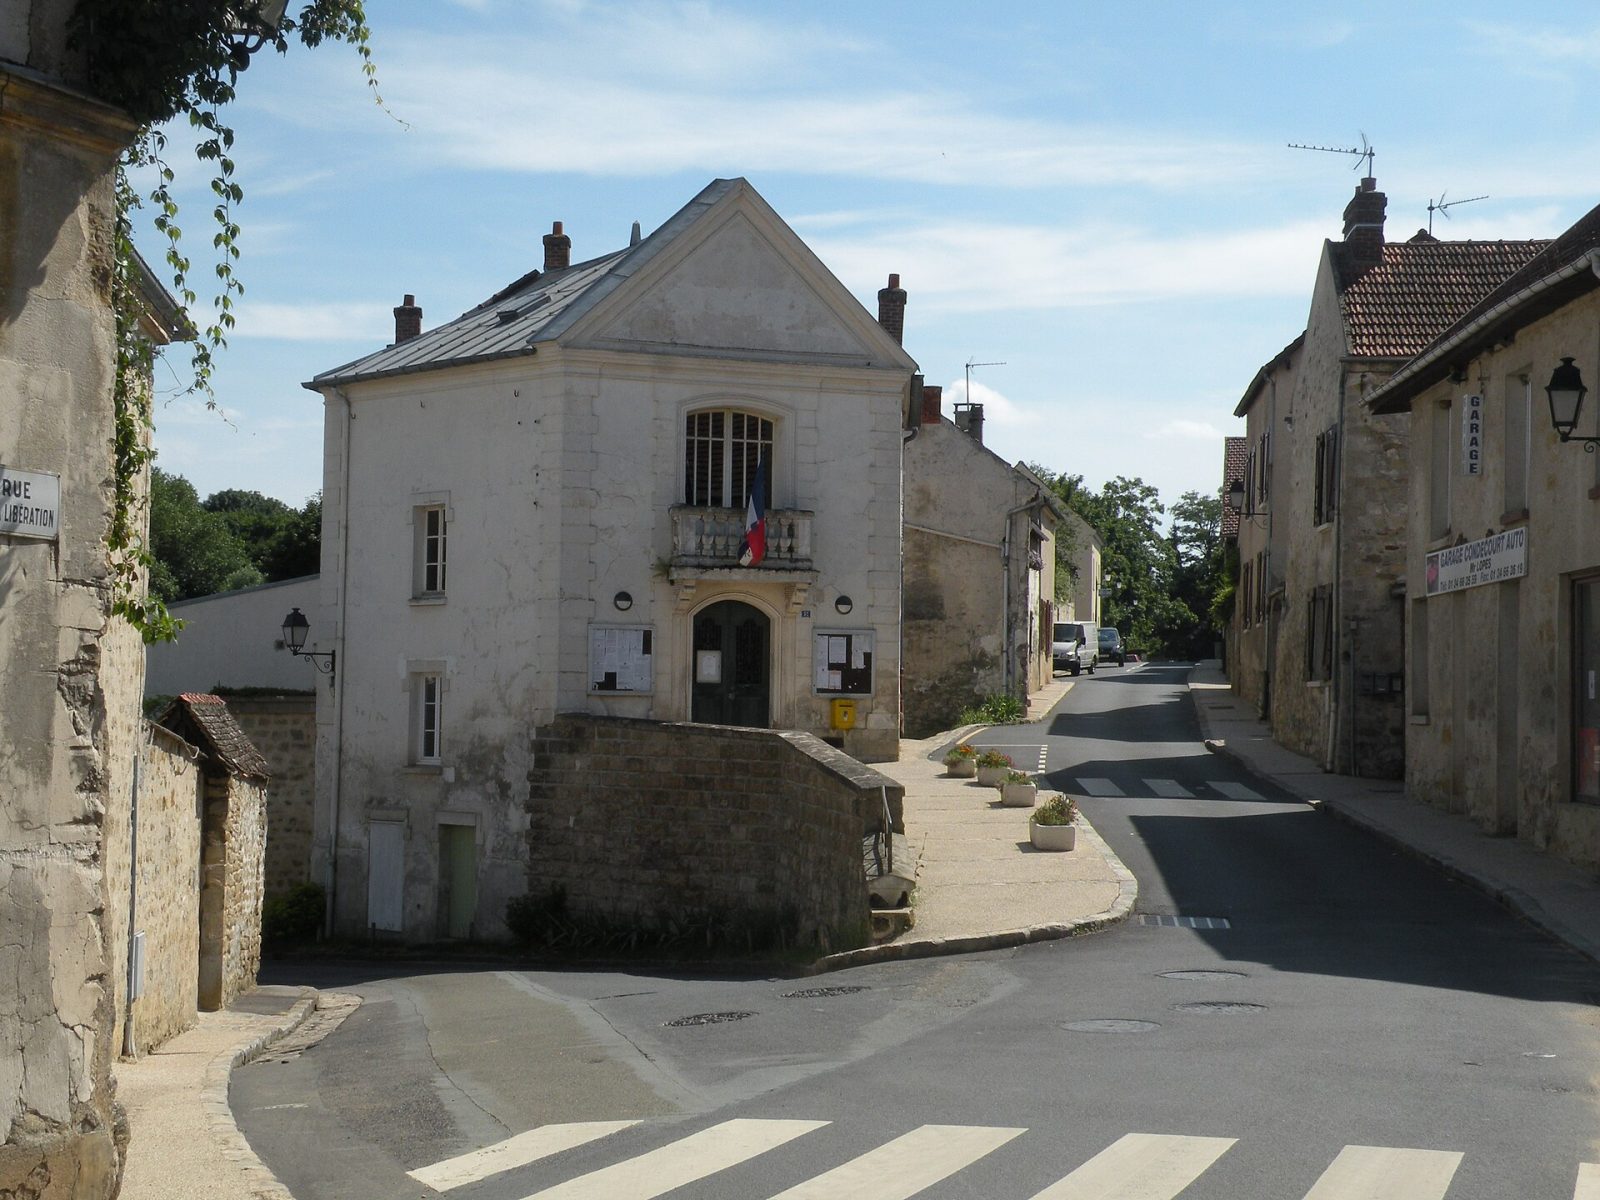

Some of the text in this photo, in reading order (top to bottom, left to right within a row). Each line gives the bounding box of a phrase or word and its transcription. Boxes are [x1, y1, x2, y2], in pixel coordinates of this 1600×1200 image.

[1469, 396, 1480, 474] GARAGE
[2, 479, 31, 499] RUE
[4, 503, 55, 528] LIBÉRATION
[1440, 529, 1524, 568] GARAGE CONDECOURT AUTO
